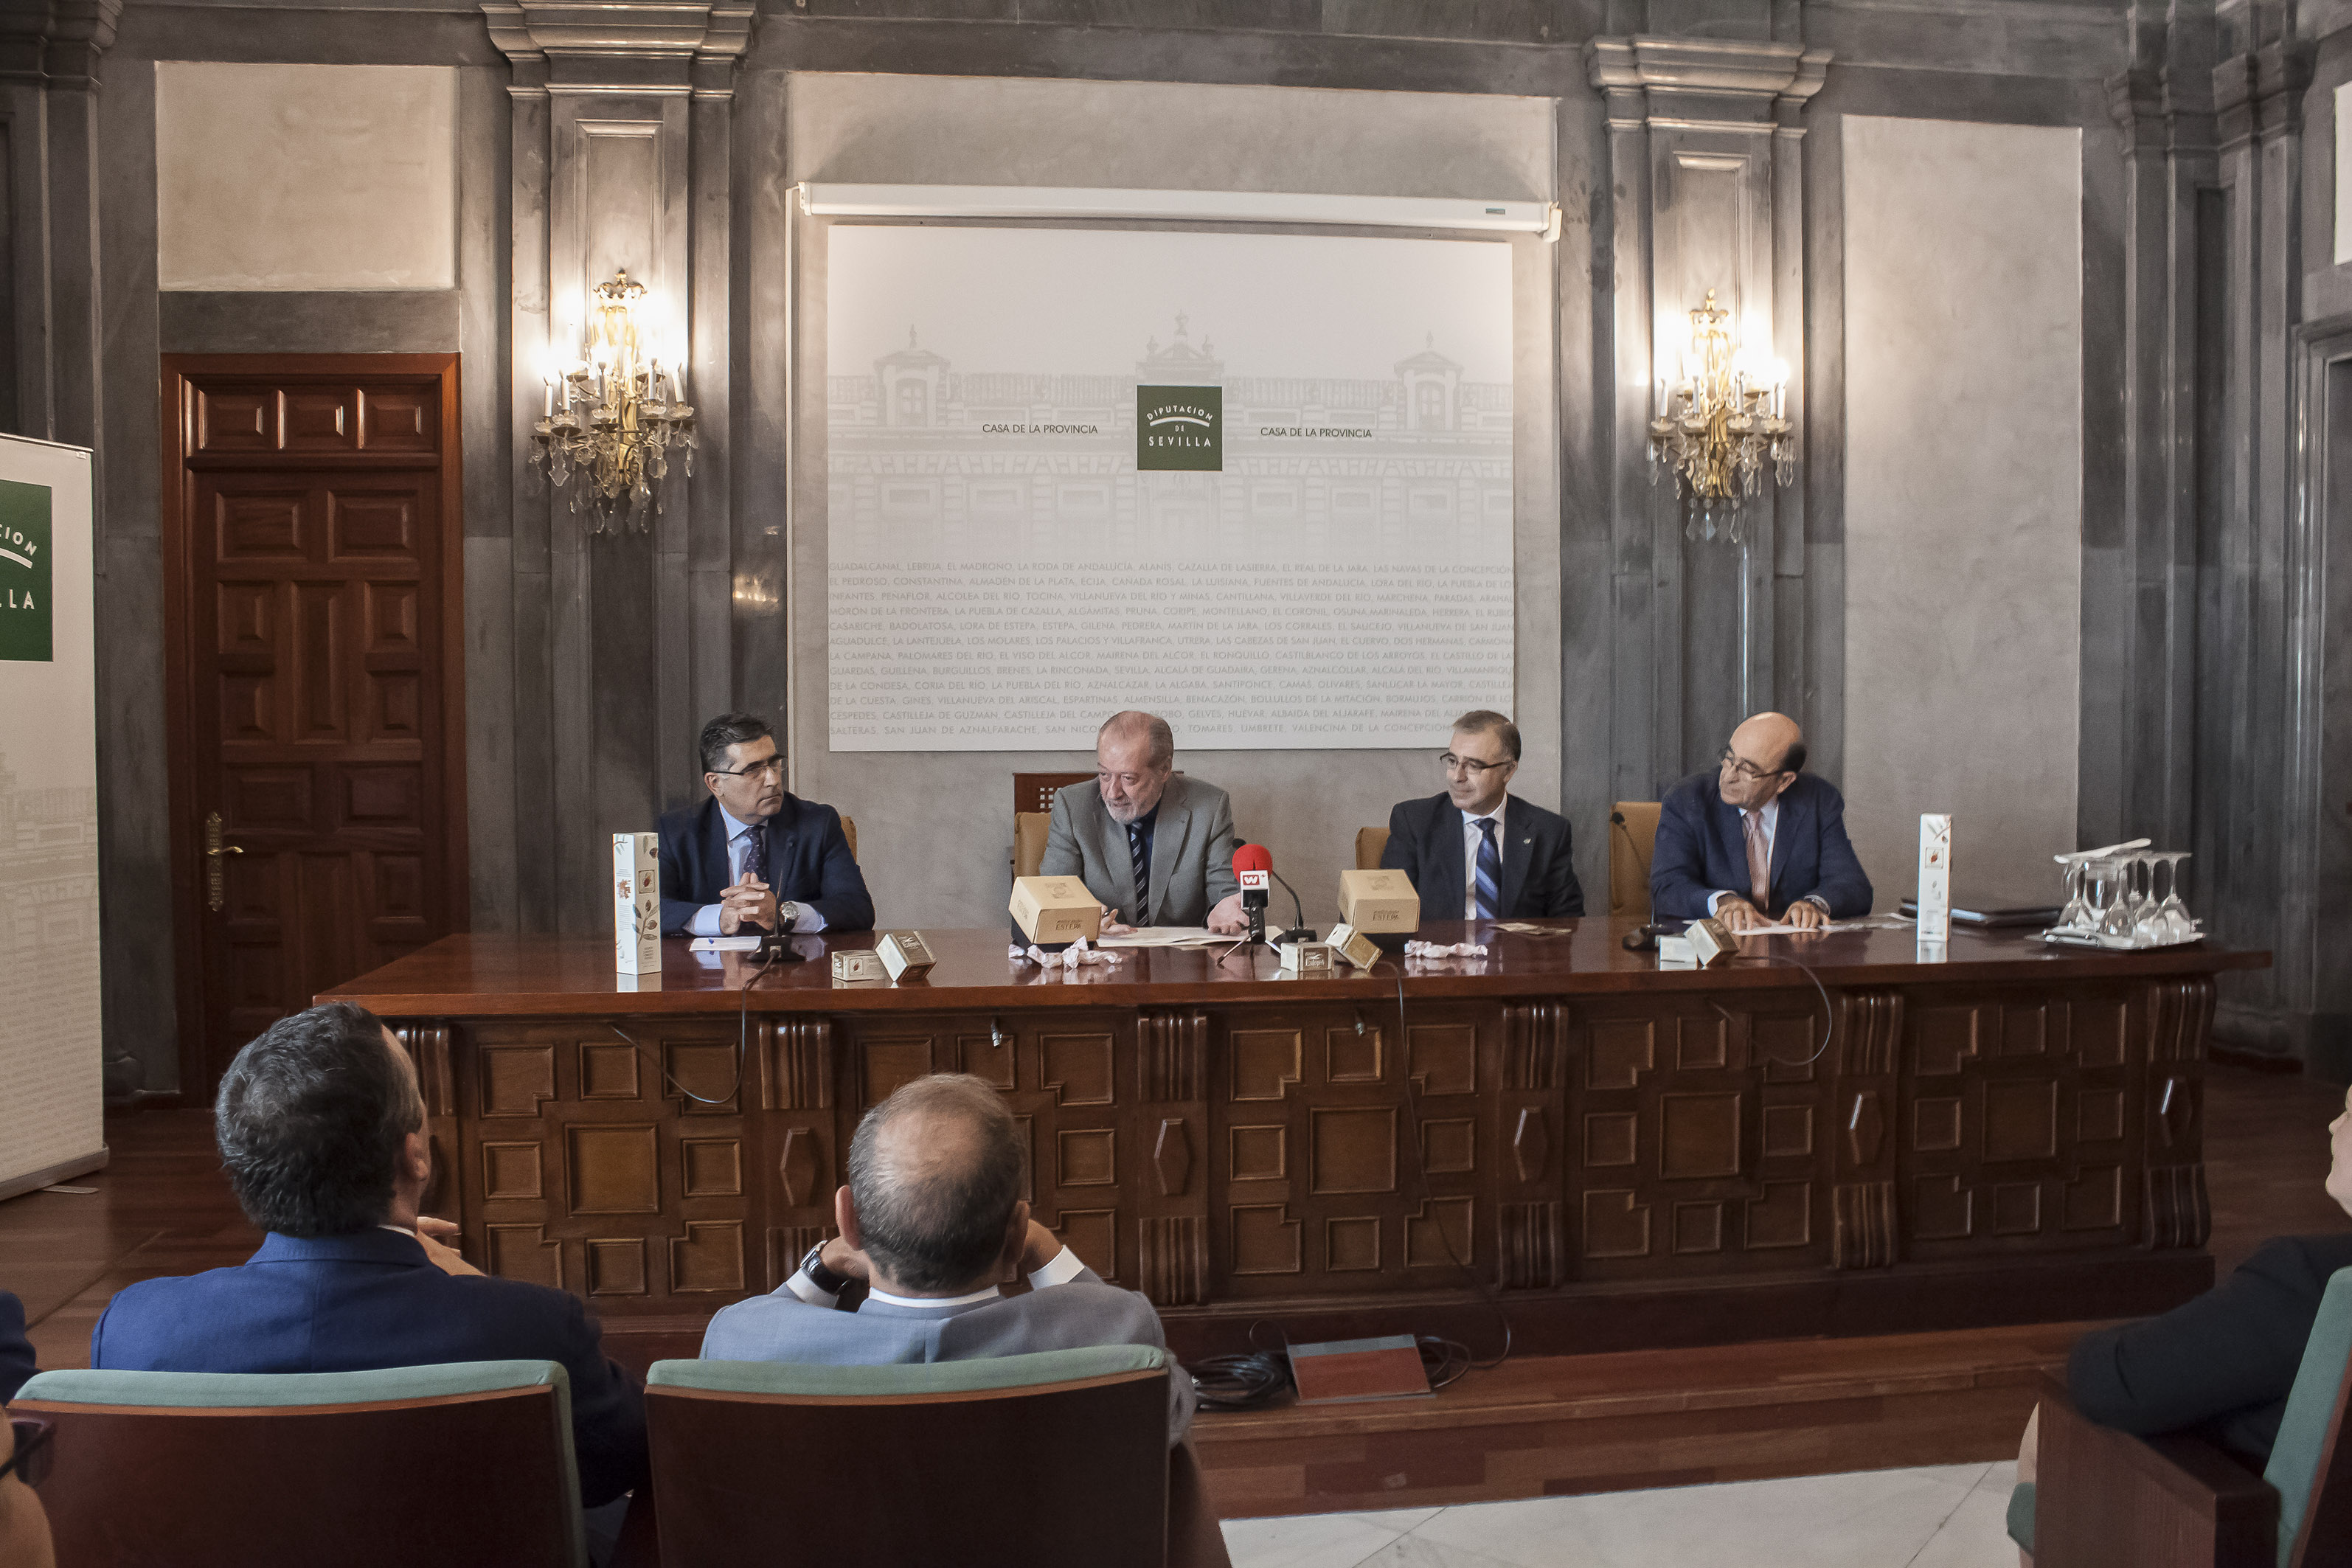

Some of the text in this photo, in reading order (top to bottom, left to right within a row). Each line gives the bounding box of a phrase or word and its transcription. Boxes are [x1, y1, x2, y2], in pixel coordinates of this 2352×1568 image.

[1146, 405, 1213, 420] DIPUTACION
[982, 424, 1098, 434] CASA DE LA PROVINCIA
[1260, 427, 1372, 437] CASA DE LA PROVINCIA
[1148, 436, 1211, 447] SEVILLA
[947, 562, 957, 571] EL
[1016, 562, 1030, 571] LA
[1031, 562, 1059, 571] RODA
[1062, 562, 1075, 571] DE
[1177, 563, 1218, 571] CAZALLA
[1220, 563, 1233, 571] DE
[1282, 563, 1292, 572] EL
[1294, 563, 1316, 572] REAL
[1318, 564, 1331, 572] DE
[1332, 564, 1344, 572] LA
[1373, 564, 1390, 572] LAS
[1391, 564, 1422, 572] NAVAS
[1423, 565, 1437, 573] DE
[1438, 565, 1450, 573] LA
[1018, 577, 1031, 586] DE
[1033, 577, 1045, 586] LA
[1192, 577, 1204, 586] LA
[1254, 578, 1294, 586] FUENTES
[1297, 578, 1308, 586] DE
[1370, 579, 1395, 587] LORA
[1397, 579, 1413, 587] DEL
[1437, 579, 1449, 587] LA
[1450, 580, 1482, 588] PUEBLA
[1485, 580, 1497, 588] DE
[935, 592, 980, 600] ALCOLEA
[982, 592, 1000, 600] DEL
[1069, 592, 1127, 600] VILLANUEVA
[1130, 592, 1148, 600] DEL
[1170, 592, 1176, 600] Y
[1279, 592, 1332, 600] VILLAVERDE
[1335, 593, 1351, 601] DEL
[870, 606, 884, 615] DE
[885, 606, 898, 615] LA
[954, 606, 966, 615] LA
[968, 606, 1004, 615] PUEBLA
[1005, 606, 1019, 615] DE
[1475, 608, 1485, 617] EL
[959, 622, 985, 630] LORA
[988, 622, 1000, 630] DE
[1207, 622, 1219, 630] DE
[1221, 622, 1233, 630] LA
[1397, 622, 1451, 631] VILLANUEVA
[1454, 622, 1466, 631] DE
[1469, 622, 1488, 631] SAN
[1035, 636, 1053, 645] LOS
[1055, 636, 1100, 645] PALACIOS
[1102, 636, 1109, 645] Y
[1215, 636, 1232, 645] LAS
[1234, 636, 1274, 645] CABEZAS
[1276, 636, 1288, 645] DE
[1291, 636, 1310, 645] SAN
[1339, 636, 1350, 645] EL
[956, 651, 974, 659] DEL
[999, 651, 1010, 659] EL
[1012, 651, 1035, 659] VISO
[1038, 651, 1056, 659] DEL
[1096, 651, 1139, 659] MAIRENA
[1142, 651, 1160, 659] DEL
[1199, 651, 1210, 659] EL
[1274, 651, 1344, 659] CASTILBLANCO
[1347, 651, 1359, 659] DE
[1361, 651, 1379, 659] LOS
[1430, 651, 1441, 659] EL
[1443, 651, 1484, 659] CASTILLO
[1486, 651, 1499, 659] DE
[1035, 666, 1048, 674] LA
[1190, 665, 1204, 674] DE
[1407, 665, 1423, 674] DEL
[947, 681, 966, 689] DEL
[991, 681, 1003, 689] LA
[1005, 681, 1041, 689] PUEBLA
[1043, 681, 1061, 689] DEL
[1155, 680, 1167, 689] LA
[1417, 680, 1428, 689] LA
[844, 696, 857, 705] LA
[937, 695, 996, 704] VILLANUEVA
[998, 695, 1016, 704] DEL
[1249, 695, 1302, 703] BOLLULLOS
[882, 711, 934, 719] CASTILLEJA
[938, 711, 951, 719] DE
[1003, 710, 1056, 718] CASTILLEJA
[1059, 710, 1077, 718] DEL
[1269, 710, 1310, 718] ALBAIDA
[883, 726, 906, 734] SAN
[909, 726, 937, 734] JUAN
[1044, 725, 1066, 733] SAN
[1291, 724, 1347, 732] VALENCINA
[1351, 724, 1364, 732] DE
[1367, 724, 1379, 732] LA
